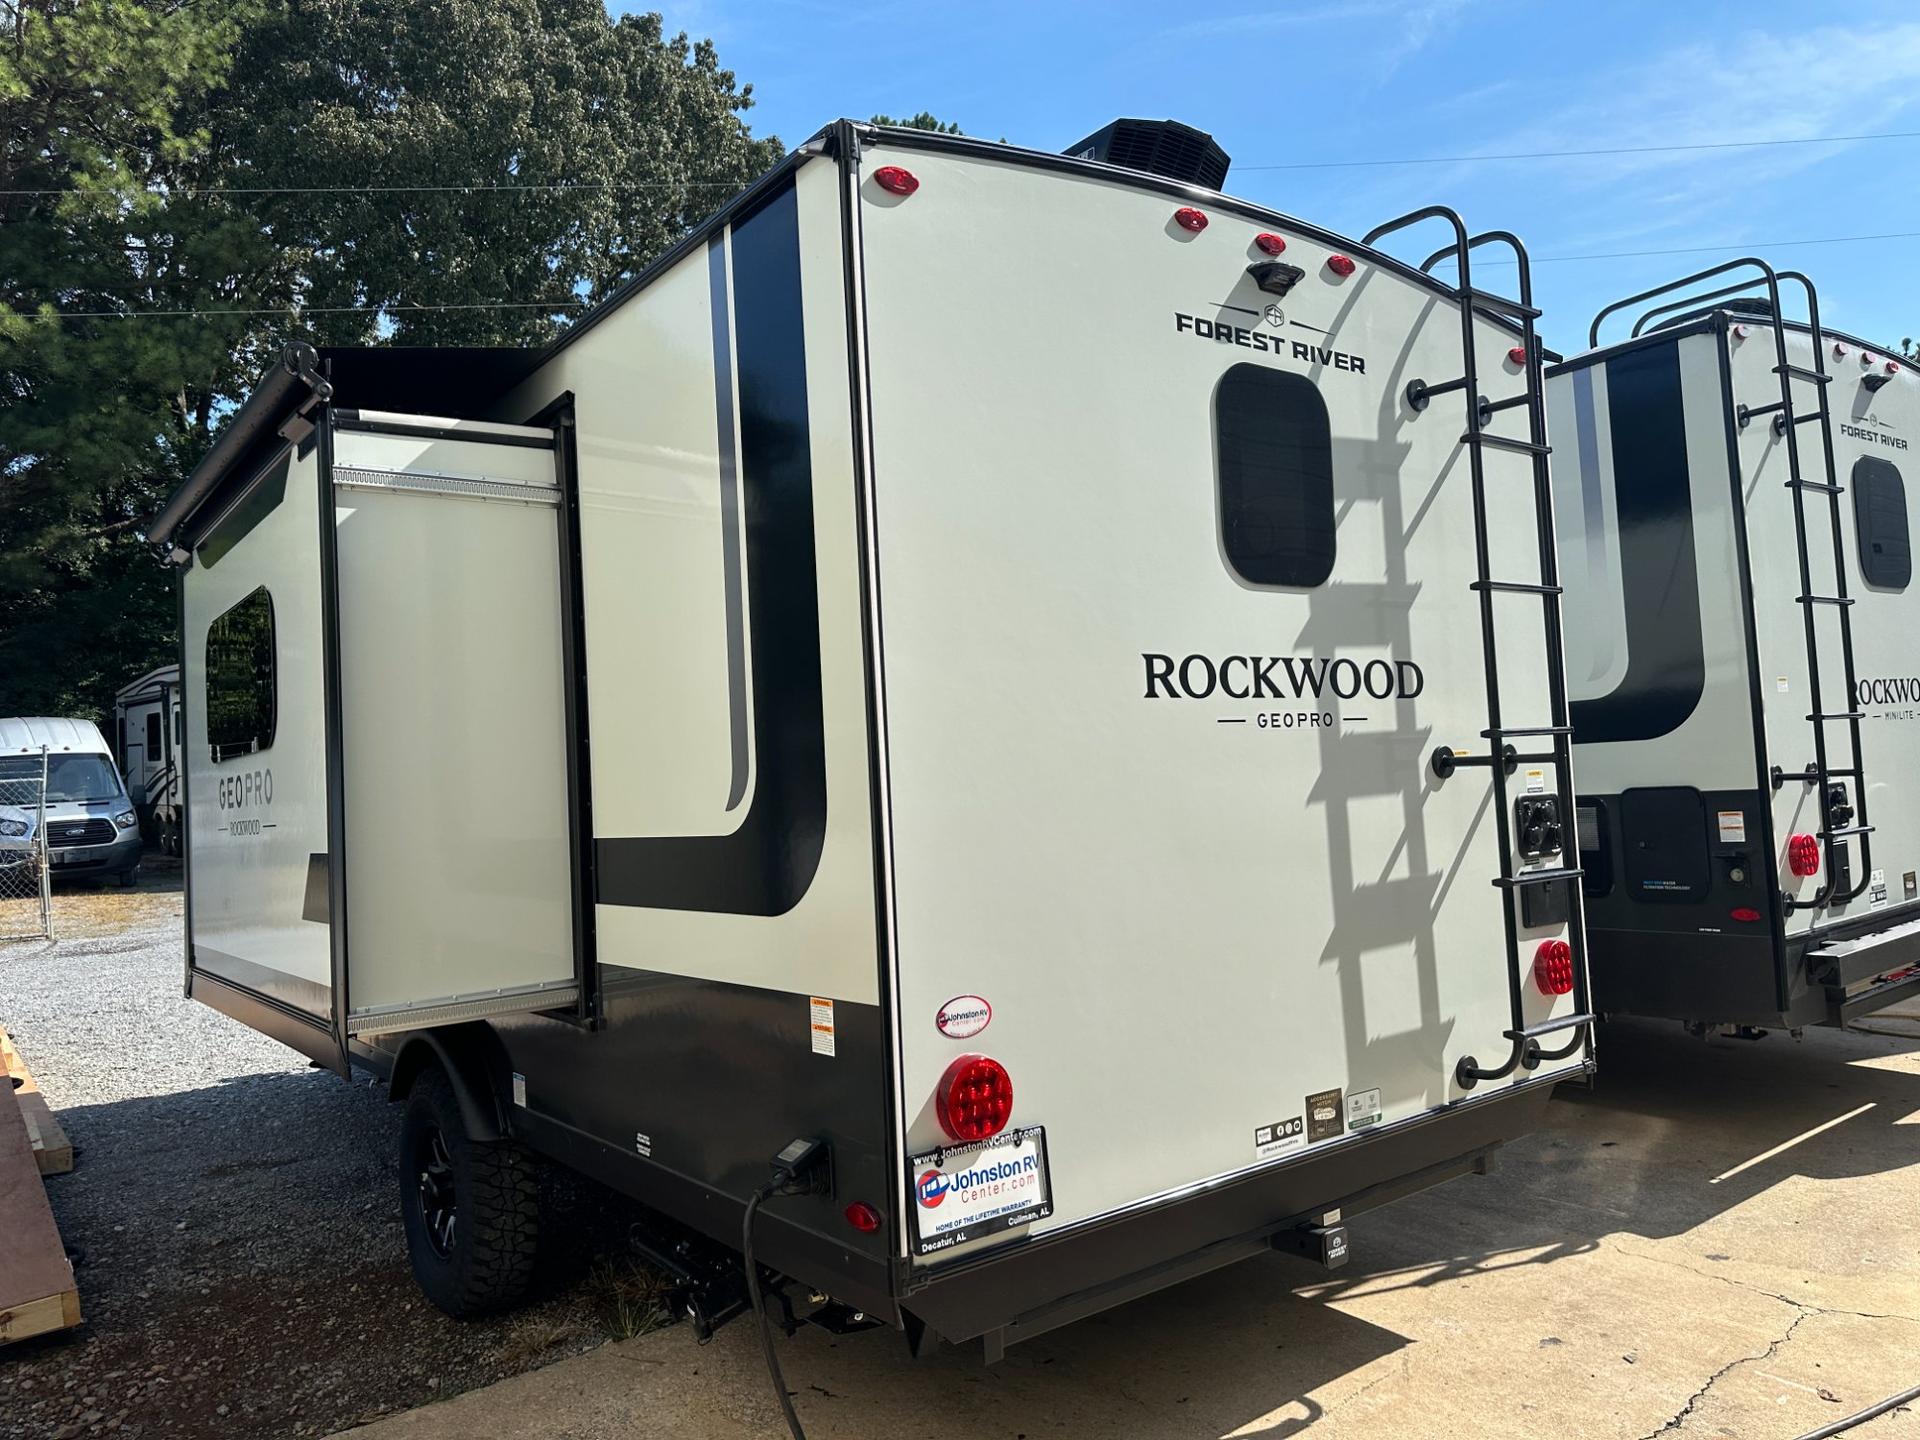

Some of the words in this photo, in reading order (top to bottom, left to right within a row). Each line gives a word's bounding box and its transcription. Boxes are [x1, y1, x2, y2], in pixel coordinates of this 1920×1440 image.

[1174, 312, 1286, 354] FOREST
[1291, 340, 1366, 375] RIVER
[1840, 423, 1879, 443] FOREST
[1880, 434, 1909, 451] RIVER
[1141, 653, 1424, 700] ROCKWOOD
[1256, 712, 1334, 729] GEOPRO
[218, 768, 274, 811] GEOPRO
[229, 819, 261, 836] ROCKWOOD
[947, 1010, 979, 1022] Johnston
[951, 1159, 1022, 1192] Johnston
[1023, 1152, 1040, 1172] RV
[961, 1174, 1036, 1204] Center.com
[935, 1221, 953, 1232] HOME
[953, 1219, 963, 1227] OF
[963, 1215, 975, 1225] THE
[975, 1208, 1000, 1221] LIFETIME
[1000, 1199, 1032, 1214] WARRANTY
[1039, 1207, 1050, 1216] AL
[921, 1236, 955, 1252] Decatur,
[955, 1232, 967, 1242] AL
